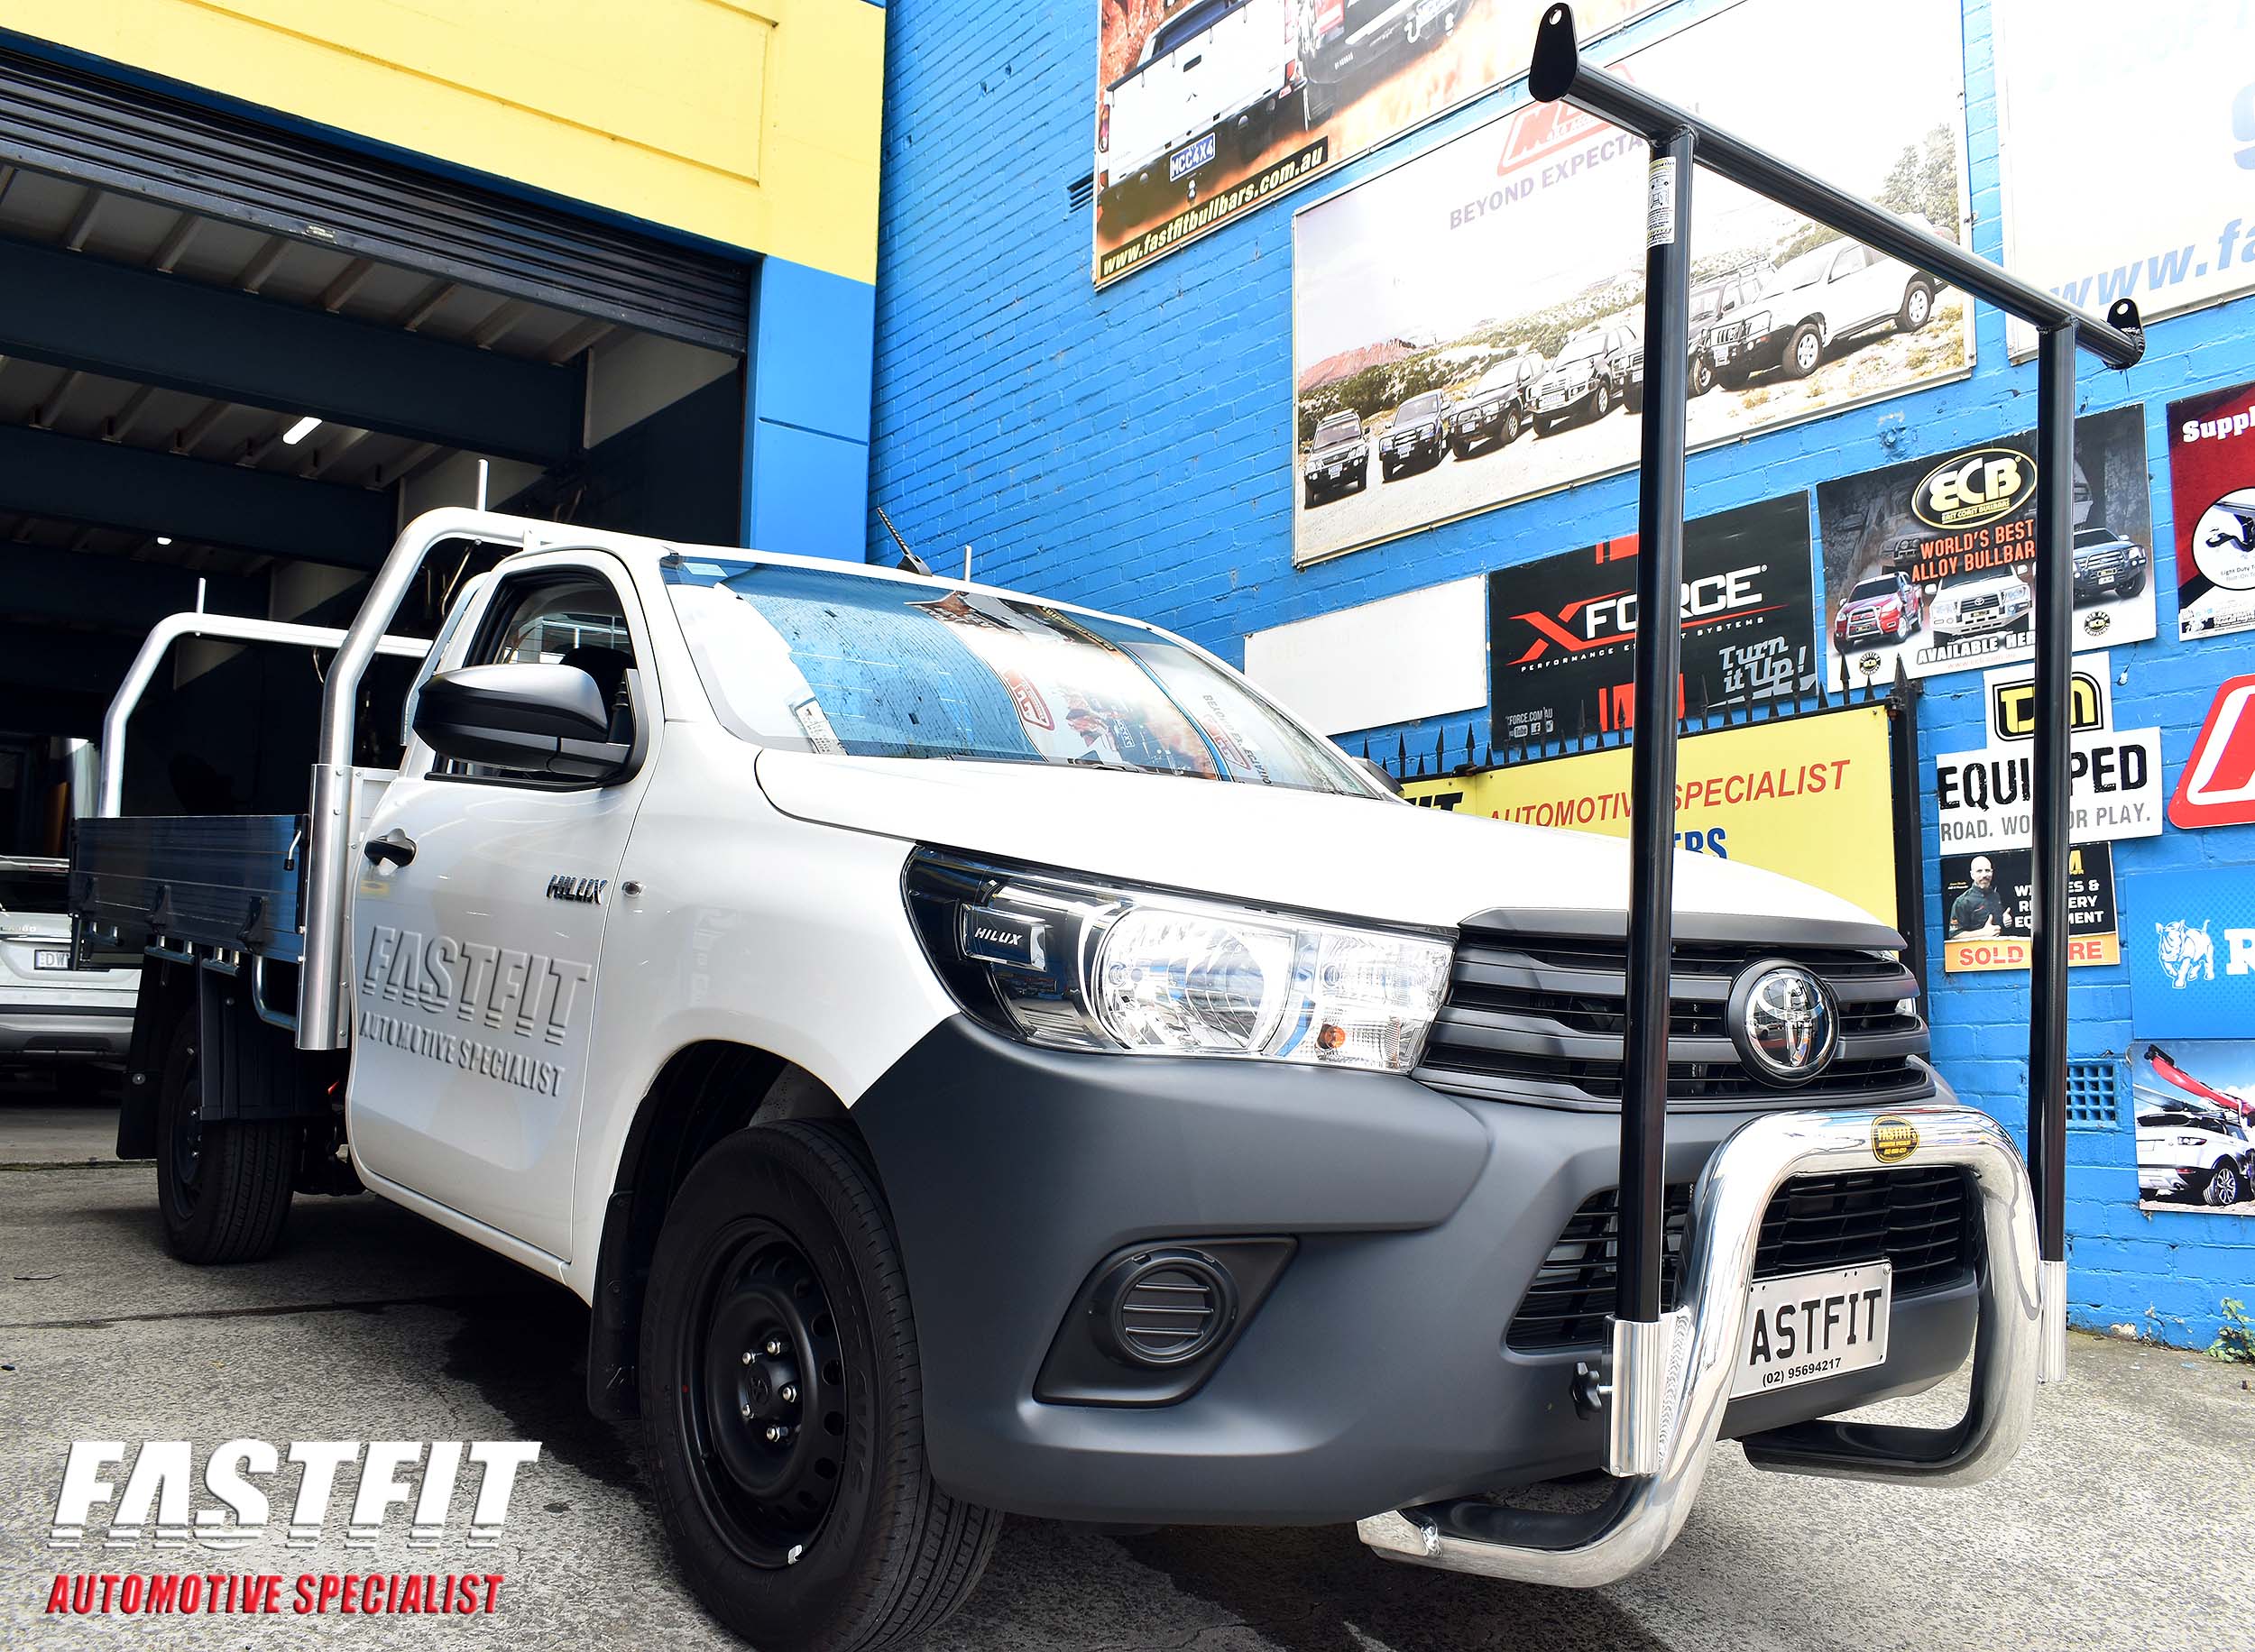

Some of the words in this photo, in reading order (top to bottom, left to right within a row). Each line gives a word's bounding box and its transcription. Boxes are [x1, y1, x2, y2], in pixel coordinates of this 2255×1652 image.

[1172, 138, 1214, 176] MCC4X4
[1450, 177, 1540, 230] BEYOND
[1542, 133, 1643, 189] EXPECTA
[1103, 146, 1323, 275] www.fastfitbullbars.com.au
[1929, 457, 2021, 512] ECB
[1920, 528, 1990, 560] WORLD'S
[1995, 519, 2035, 545] BEST
[1912, 556, 1958, 583] ALLOY
[1506, 563, 1764, 666] XFOCE
[1521, 647, 1615, 673] PERFORMANCE
[1698, 617, 1764, 637] SYSTEMS
[1719, 636, 1789, 670] Turn
[1917, 635, 1999, 665] AVAILABLE
[2005, 630, 2036, 649] HER
[1724, 668, 1744, 693] it
[1937, 744, 2148, 812] EQUIPED
[1941, 819, 1994, 842] ROAD.
[2002, 814, 2030, 836] WO
[2096, 802, 2151, 827] PLAY.
[545, 873, 608, 905] HILUX
[2088, 879, 2100, 892] &
[974, 927, 1023, 946] HILUX
[1959, 945, 2024, 967] SOLD
[362, 925, 592, 1046] FASTFIT
[359, 1011, 456, 1064] AUTOMOTIVE
[457, 1039, 566, 1097] SPECIALIST
[1763, 1369, 1785, 1388] (02)
[1788, 1356, 1842, 1380] 95694217
